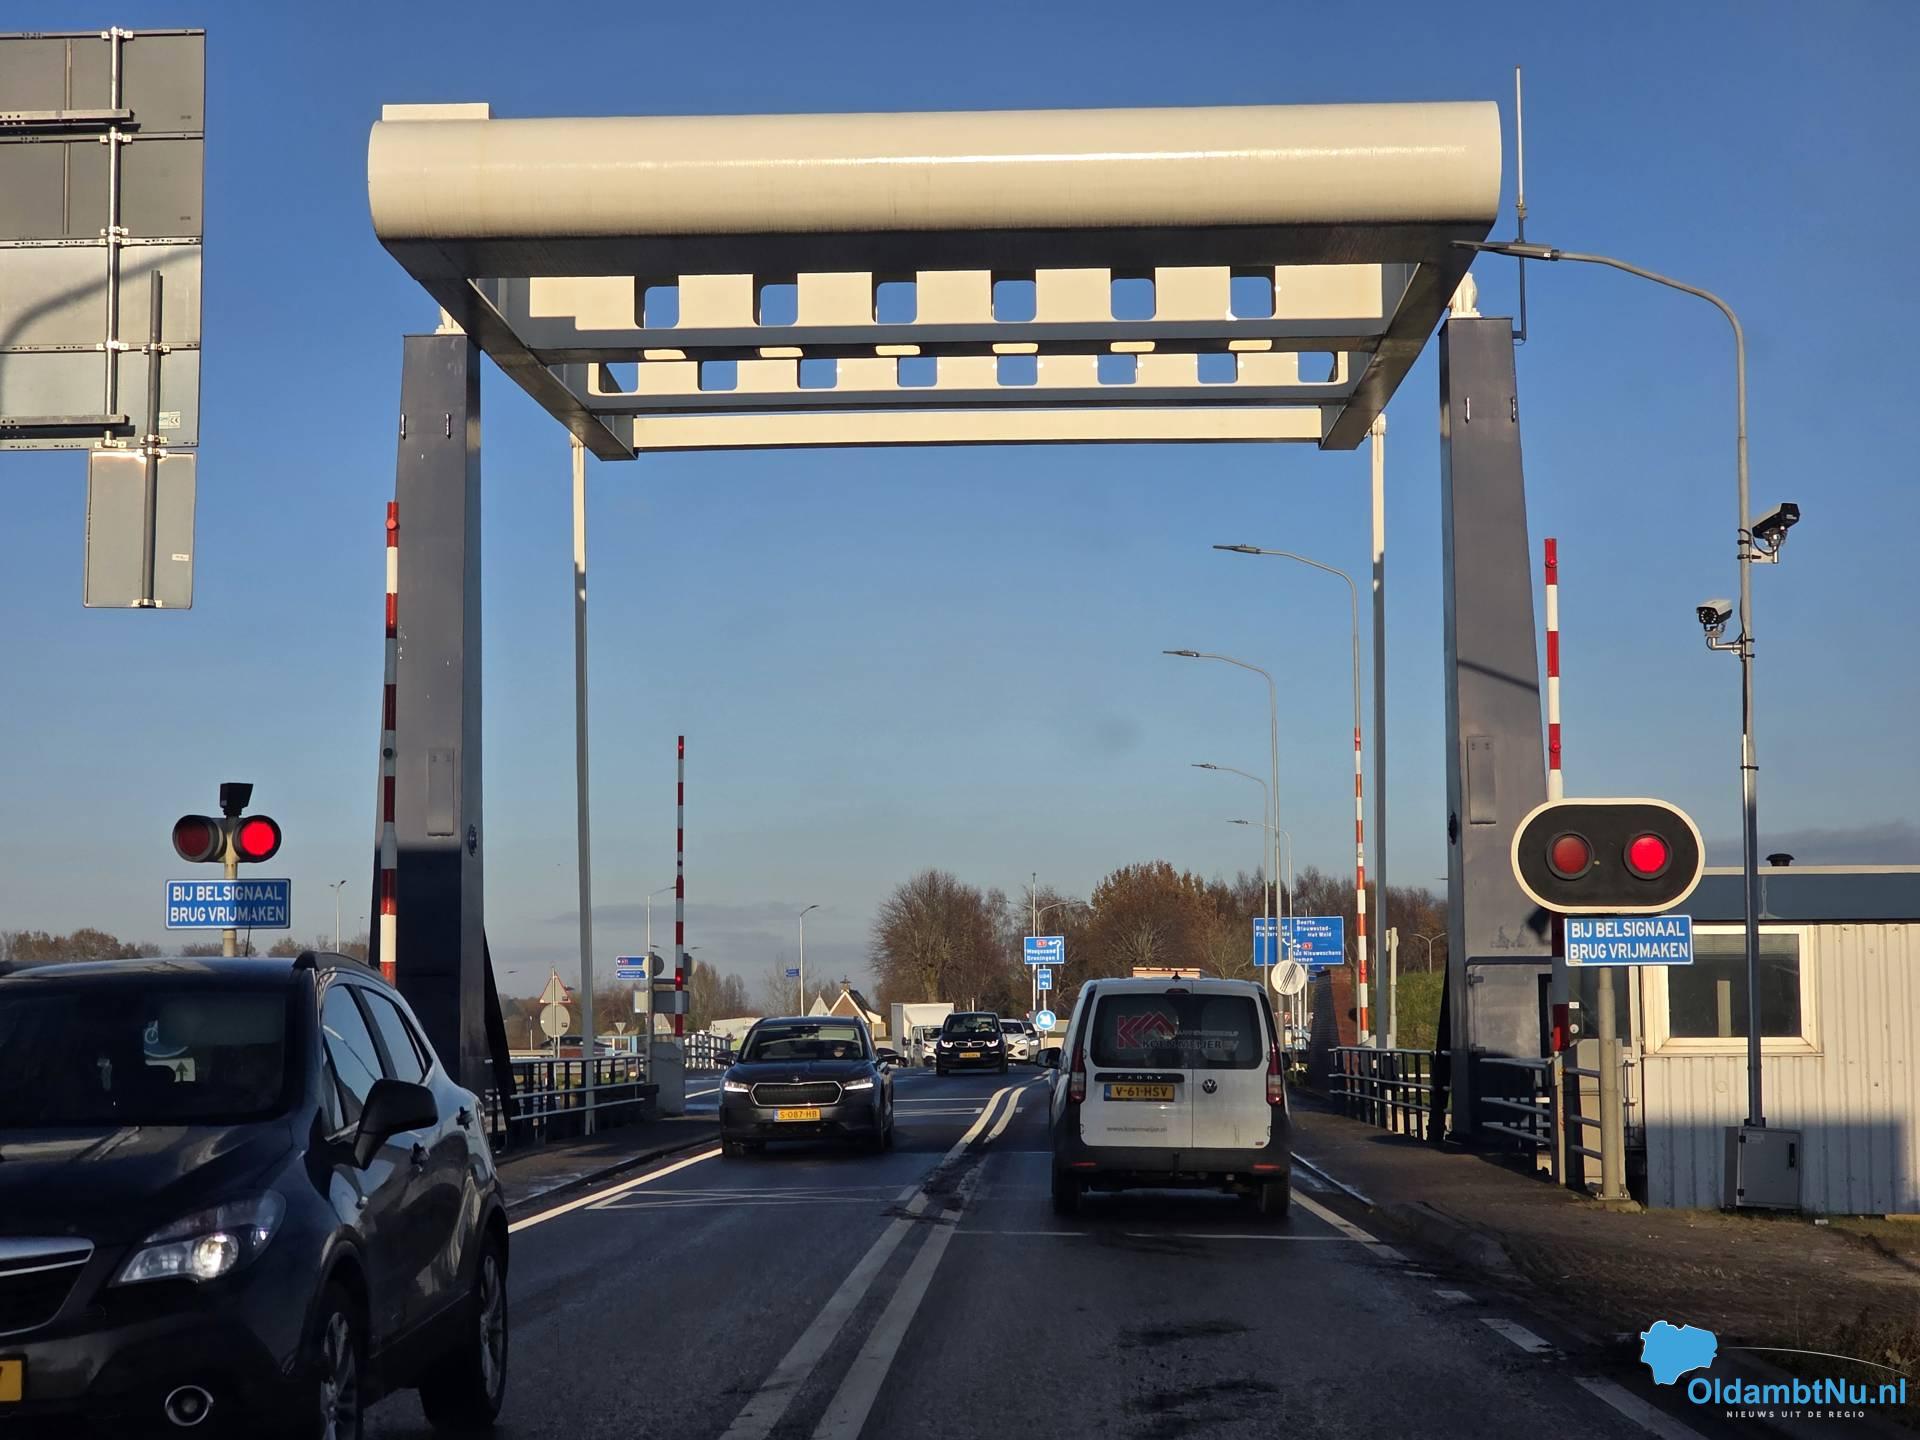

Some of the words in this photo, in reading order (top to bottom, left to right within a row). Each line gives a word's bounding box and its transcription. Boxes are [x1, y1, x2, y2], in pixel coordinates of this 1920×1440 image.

[173, 886, 193, 901] BIJ
[197, 885, 282, 901] BELSIGNAAL
[171, 906, 206, 922] BRUG
[208, 905, 284, 922] VRIJMAKEN
[1571, 922, 1592, 938] BIJ
[1596, 921, 1686, 937] BELSIGNAAL
[1570, 943, 1606, 959] BRUG
[1609, 942, 1688, 958] VRIJMAKEN
[1115, 1087, 1168, 1097] V-61-HSV
